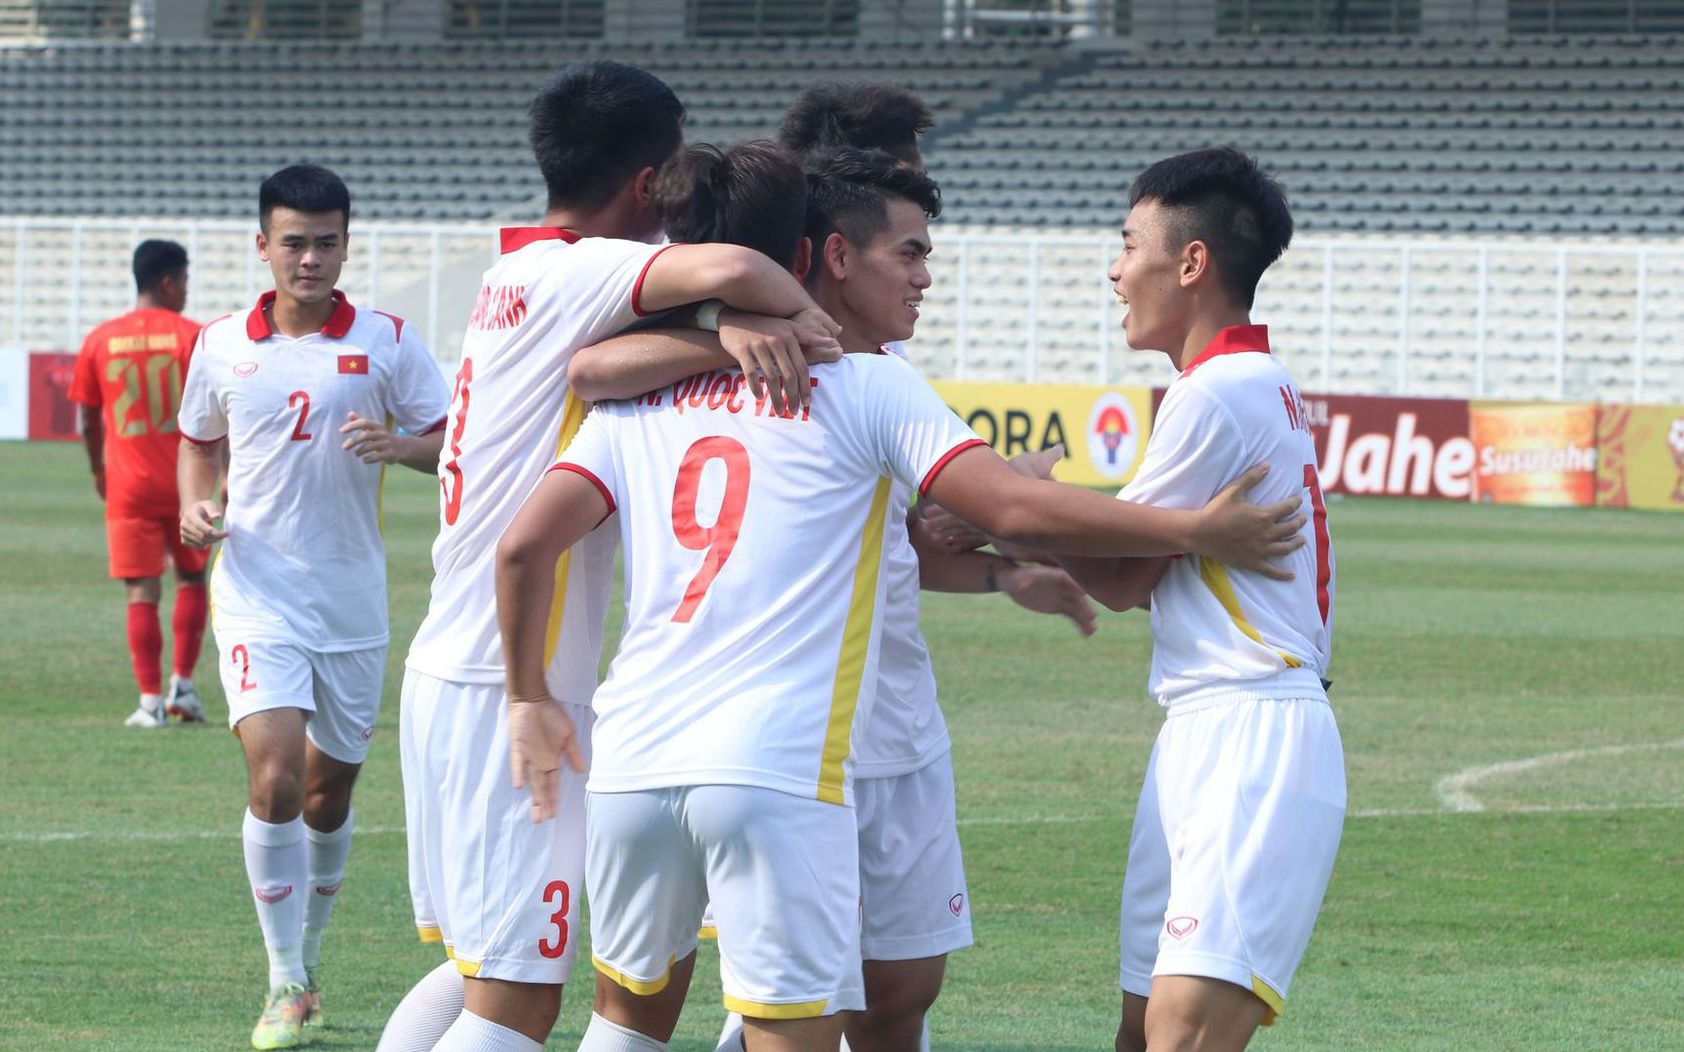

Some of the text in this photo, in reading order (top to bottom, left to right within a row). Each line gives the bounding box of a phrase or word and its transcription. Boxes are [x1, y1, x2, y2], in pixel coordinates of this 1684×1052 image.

[105, 354, 181, 437] 20
[288, 390, 312, 441] 2
[947, 407, 1070, 459] ORA
[1318, 412, 1477, 499] Jahe
[670, 435, 752, 623] 9
[231, 643, 257, 693] 2
[538, 879, 570, 959] 3
